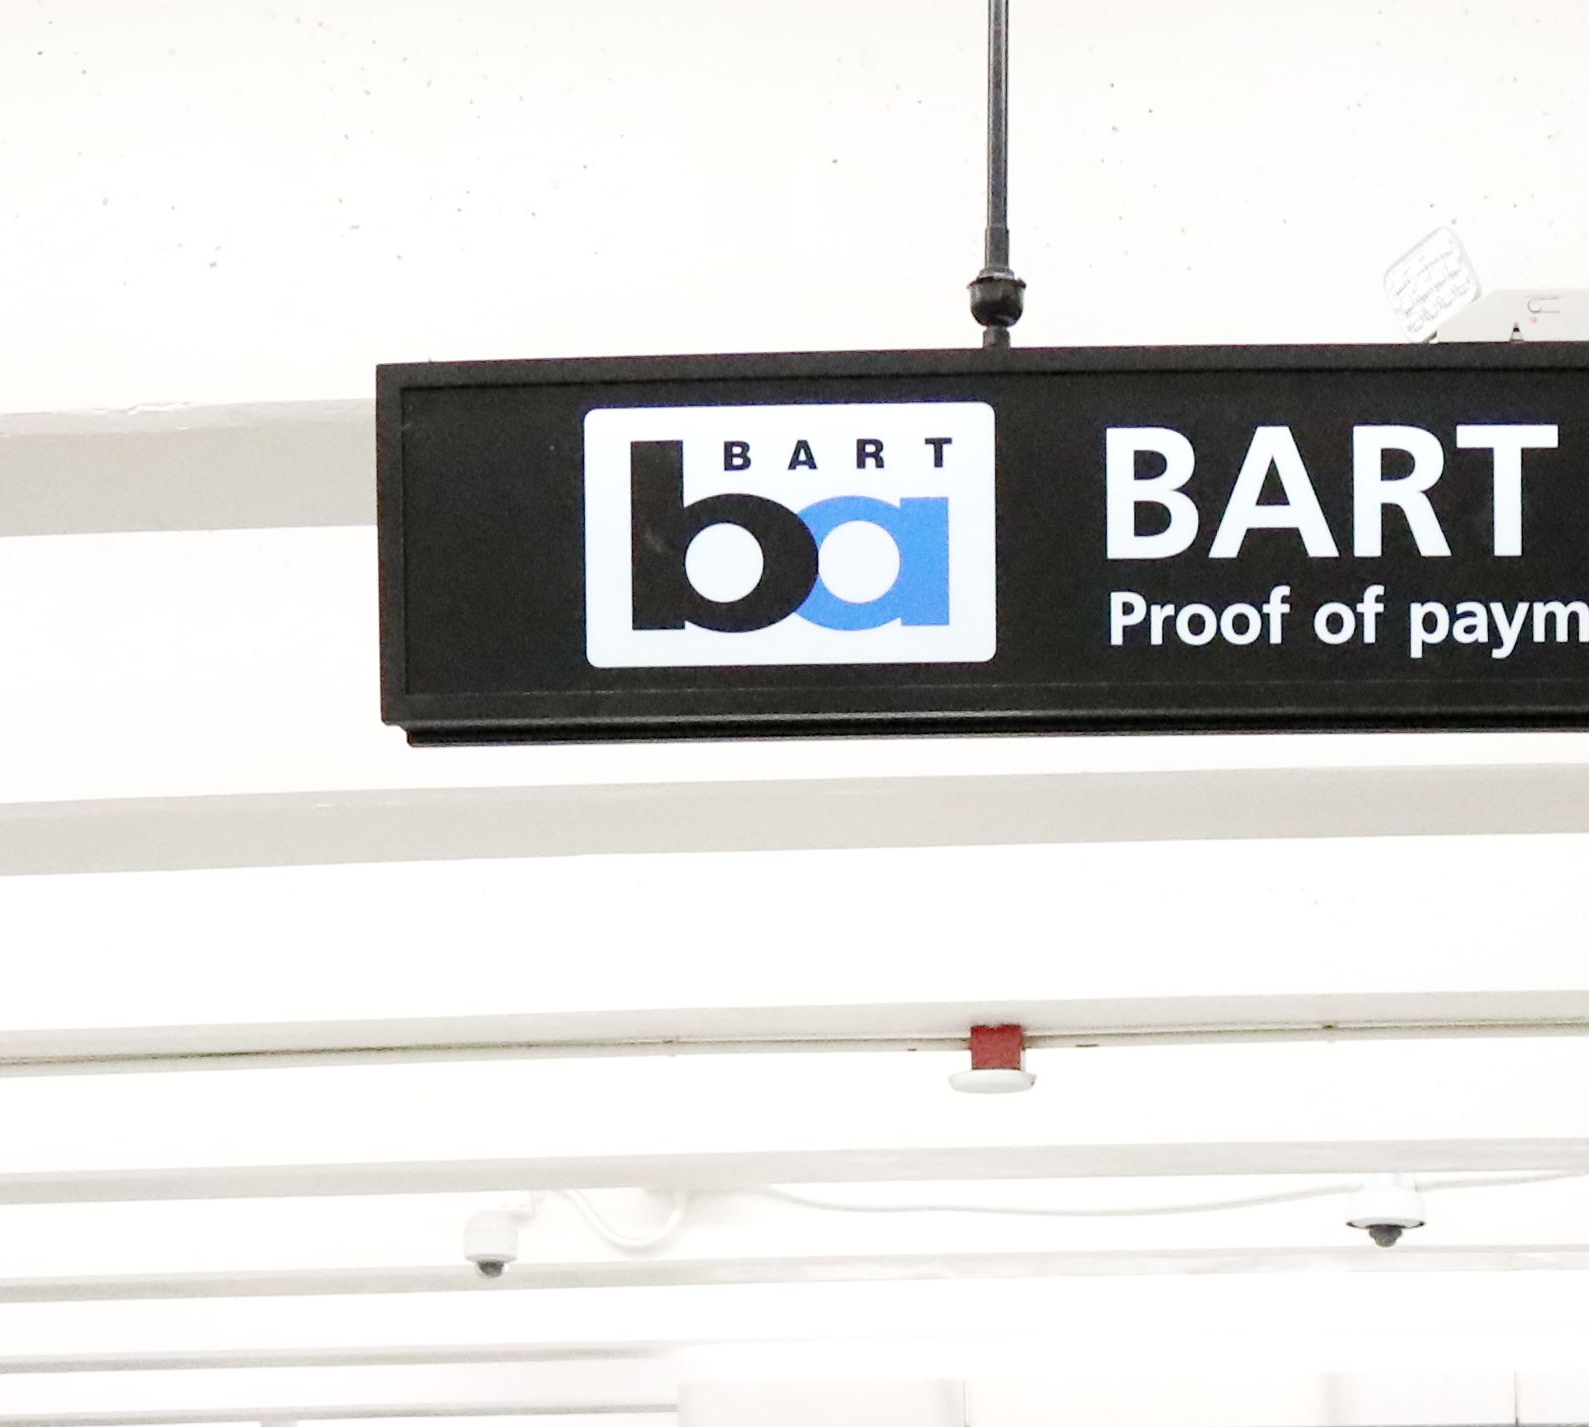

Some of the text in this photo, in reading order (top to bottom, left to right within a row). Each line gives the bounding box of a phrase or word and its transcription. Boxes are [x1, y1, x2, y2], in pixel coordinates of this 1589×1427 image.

[723, 438, 952, 471] BART
[1105, 424, 1558, 559] BART
[1109, 585, 1291, 645] Proof
[1314, 585, 1385, 645] of
